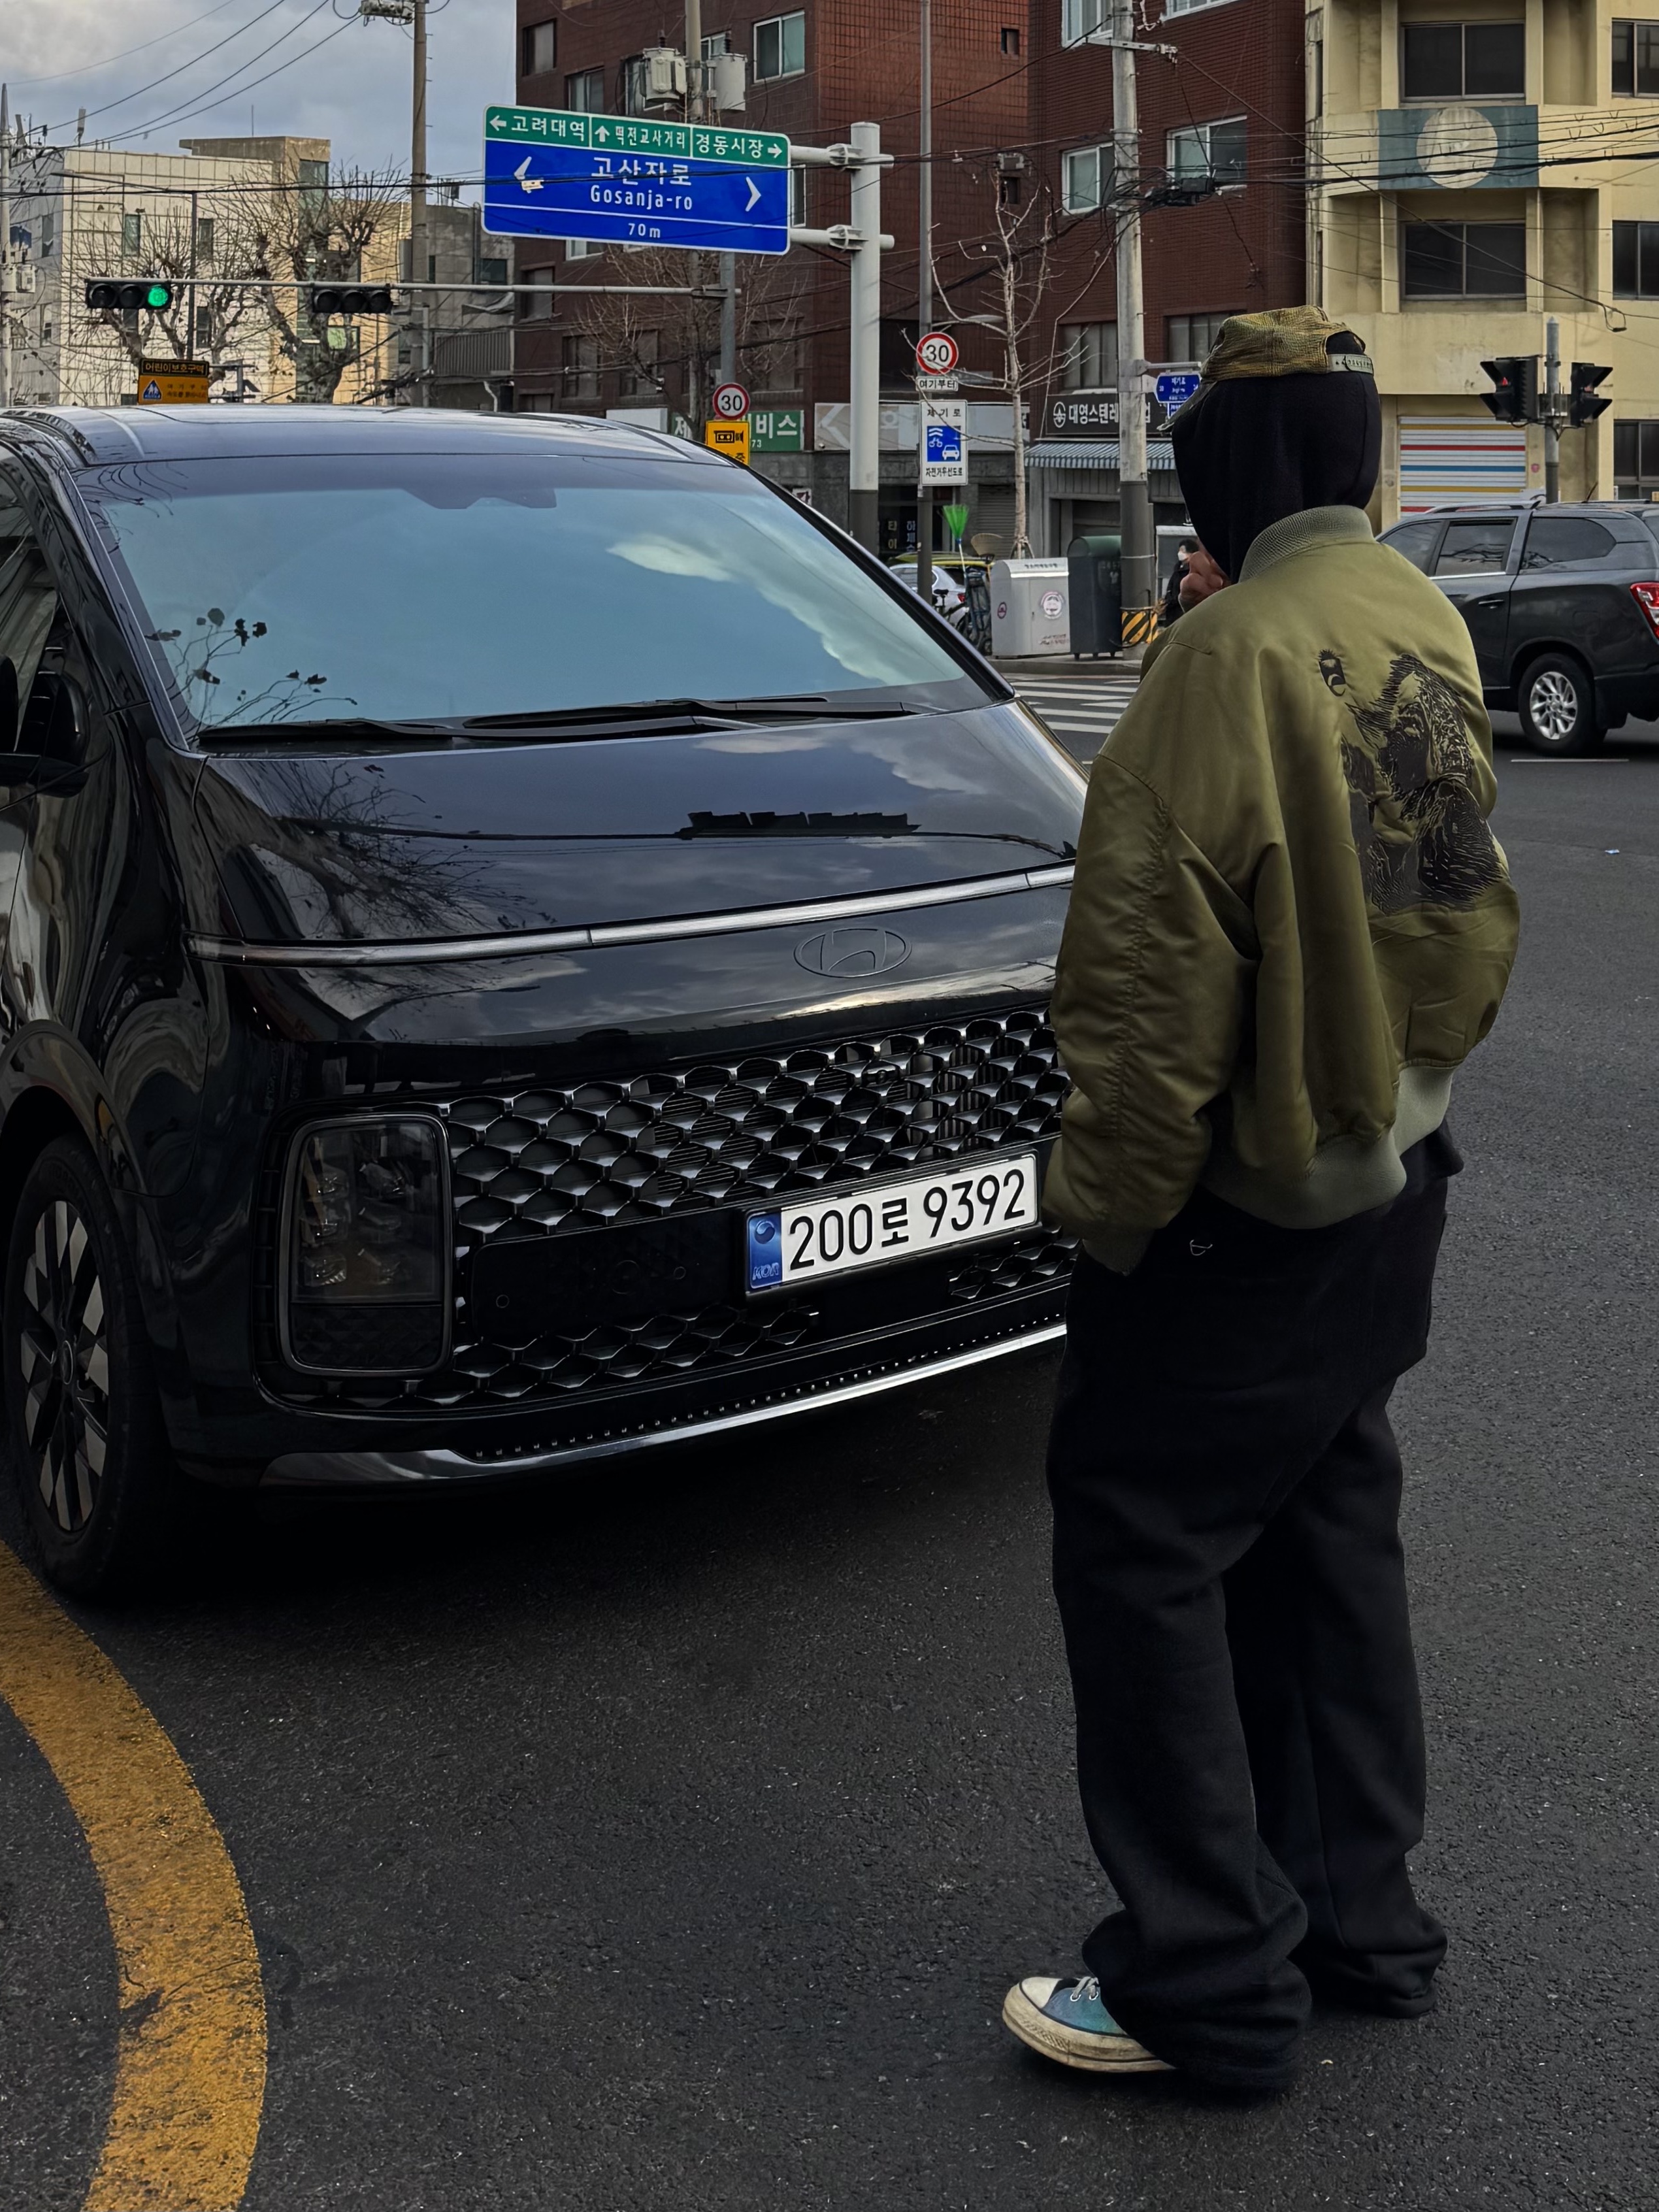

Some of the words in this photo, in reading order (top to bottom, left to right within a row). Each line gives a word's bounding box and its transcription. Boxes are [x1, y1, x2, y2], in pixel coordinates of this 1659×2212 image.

[511, 114, 585, 142] 고려대역
[616, 125, 685, 149] 떡전교사거리
[695, 133, 764, 158] 경동시장
[591, 157, 692, 186] 고산자로
[591, 185, 693, 210] Gosanja-ro
[628, 223, 661, 239] 70m
[925, 344, 949, 362] 30
[145, 361, 205, 373] 어린이보호구역
[919, 379, 956, 389] 여기부터
[721, 395, 742, 411] 30
[742, 412, 798, 438] 비스
[789, 1197, 909, 1271] 200로
[923, 1168, 1025, 1239] 9392
[752, 1262, 780, 1280] KOR
